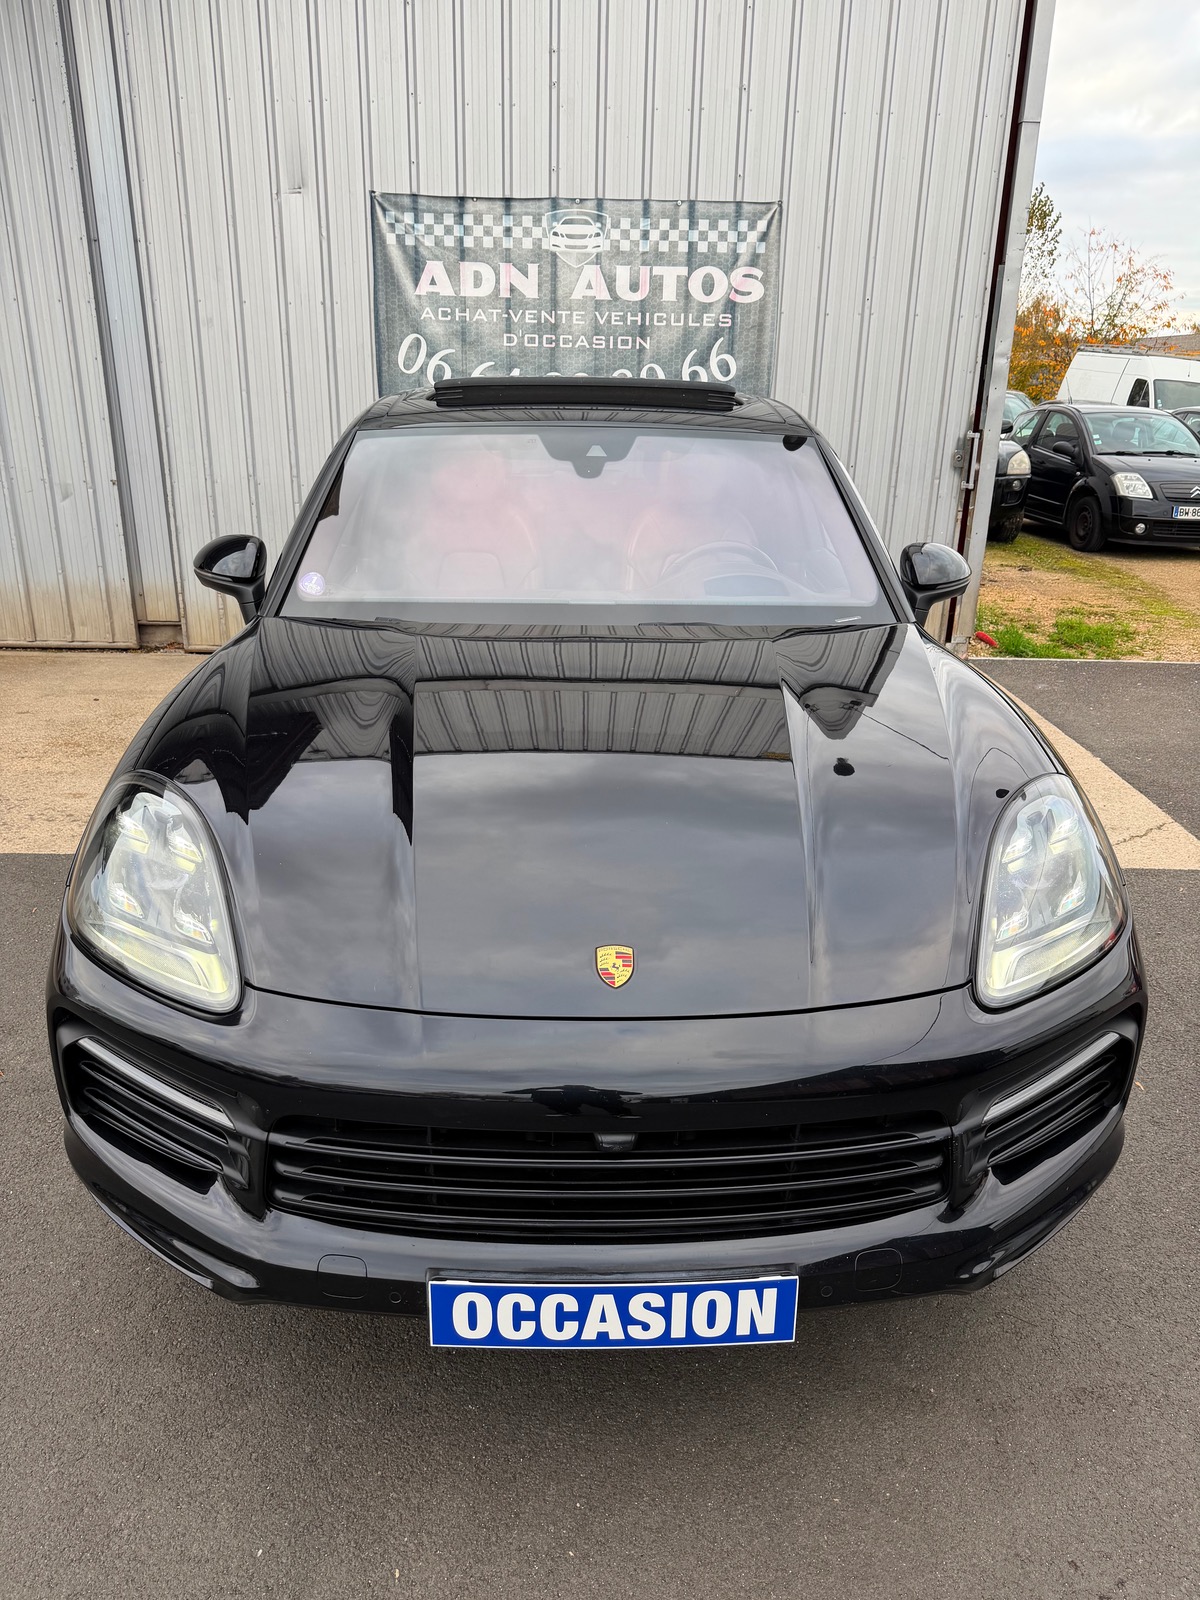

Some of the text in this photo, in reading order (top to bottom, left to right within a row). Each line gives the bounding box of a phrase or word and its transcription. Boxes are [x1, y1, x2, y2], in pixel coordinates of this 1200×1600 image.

[414, 260, 765, 304] ADN AUTOS
[420, 306, 733, 328] ACHAT-VENTE VEHICULES
[503, 329, 651, 349] D'OCCASION
[452, 1287, 778, 1341] OCCASION
